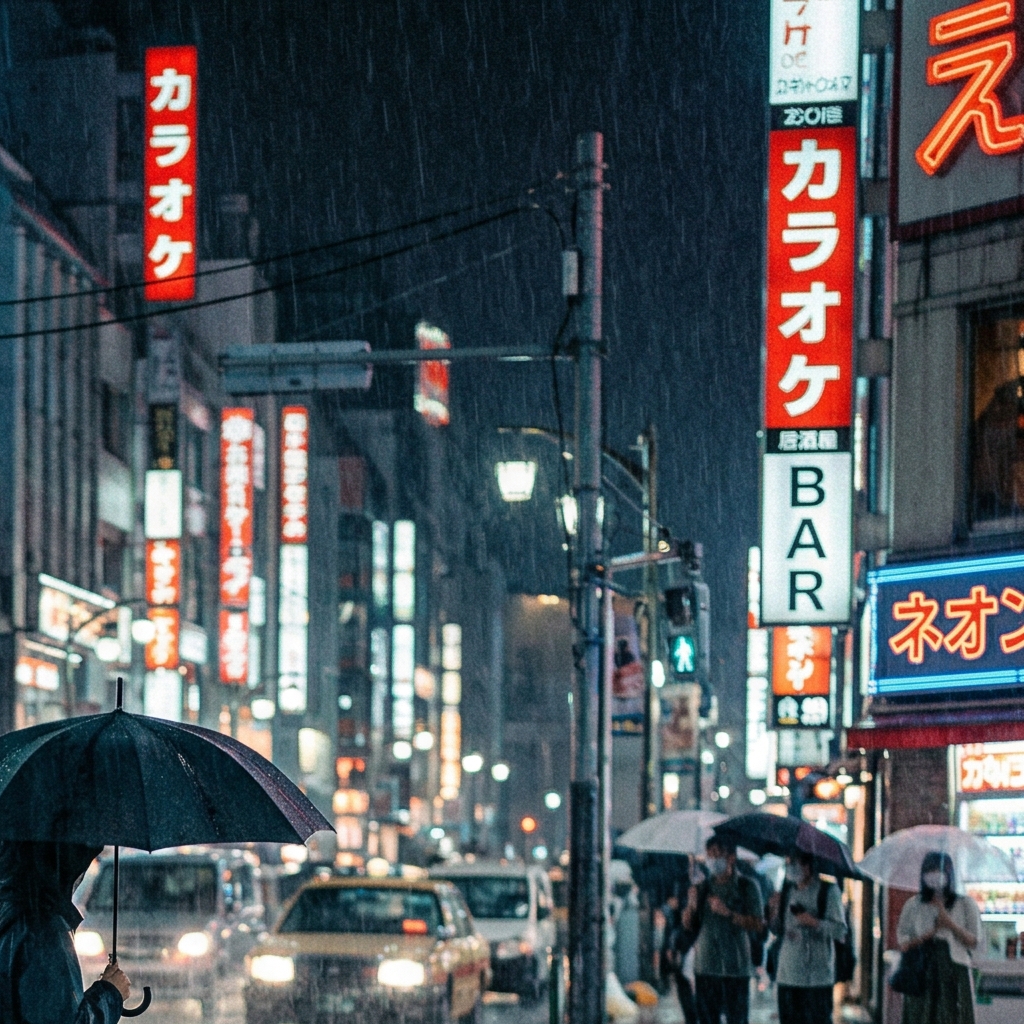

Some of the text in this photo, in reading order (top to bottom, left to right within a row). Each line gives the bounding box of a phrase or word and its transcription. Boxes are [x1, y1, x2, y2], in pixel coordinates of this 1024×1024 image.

[148, 67, 194, 280] カラオケ
[915, 0, 1024, 176] え
[777, 138, 842, 417] カラオケ
[787, 466, 826, 611] BAR
